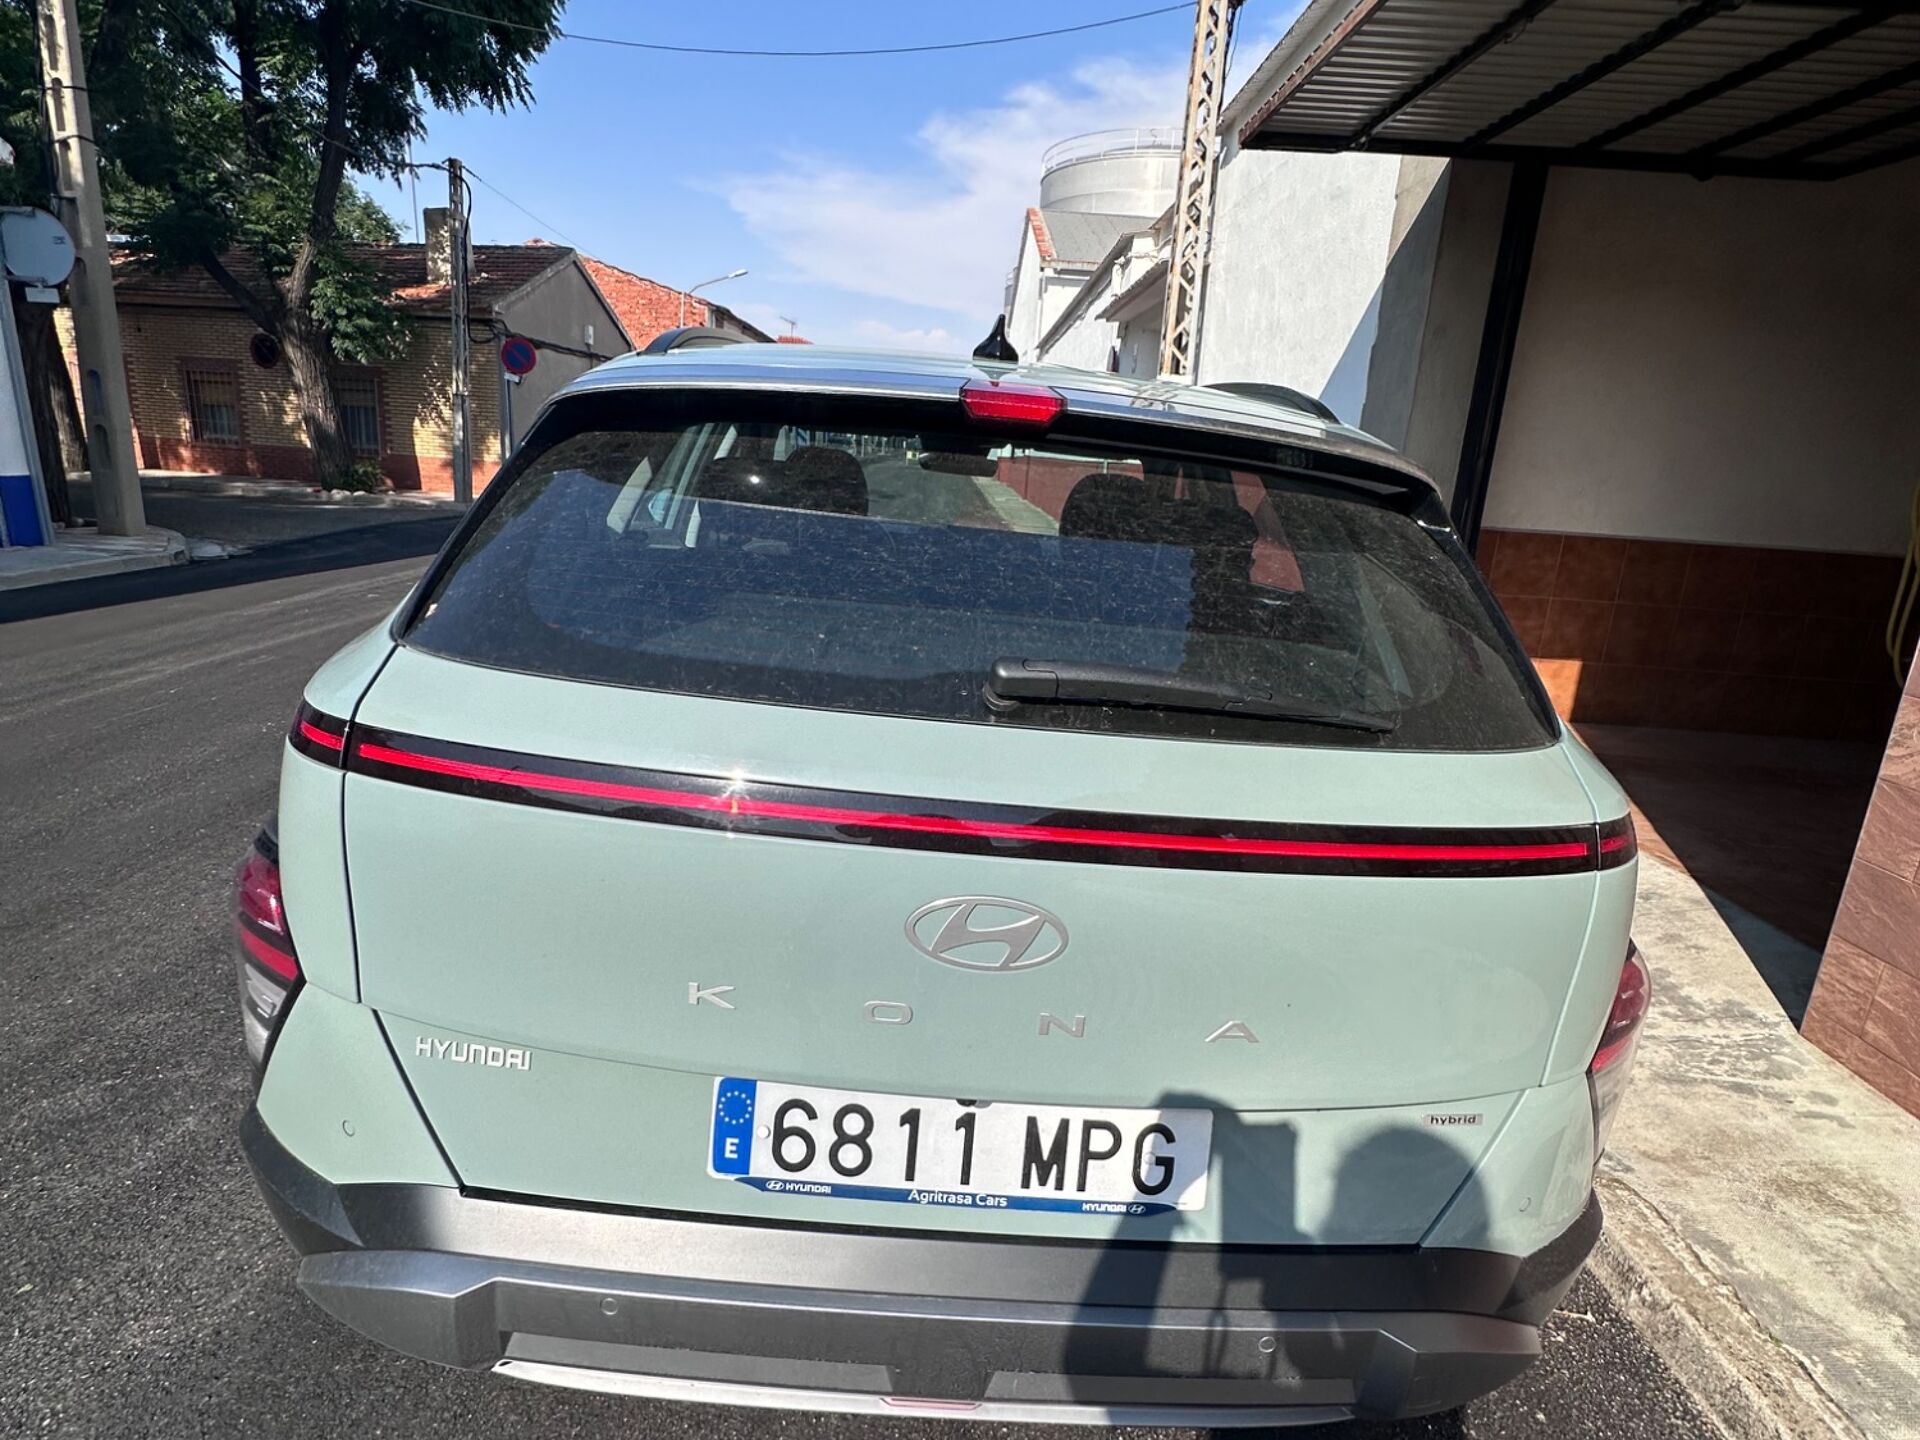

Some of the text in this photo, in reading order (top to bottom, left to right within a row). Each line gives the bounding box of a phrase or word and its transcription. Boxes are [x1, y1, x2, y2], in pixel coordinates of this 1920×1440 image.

[688, 981, 1260, 1043] KONA
[415, 1035, 533, 1071] HYUNDAI
[1430, 1114, 1477, 1126] hybrid
[724, 1137, 740, 1159] E
[771, 1098, 1177, 1196] 6811 MPG
[785, 1182, 832, 1194] HYUNDAI
[907, 1188, 1008, 1207] Agritrasa Cars
[1082, 1202, 1127, 1213] HYUNDAI
